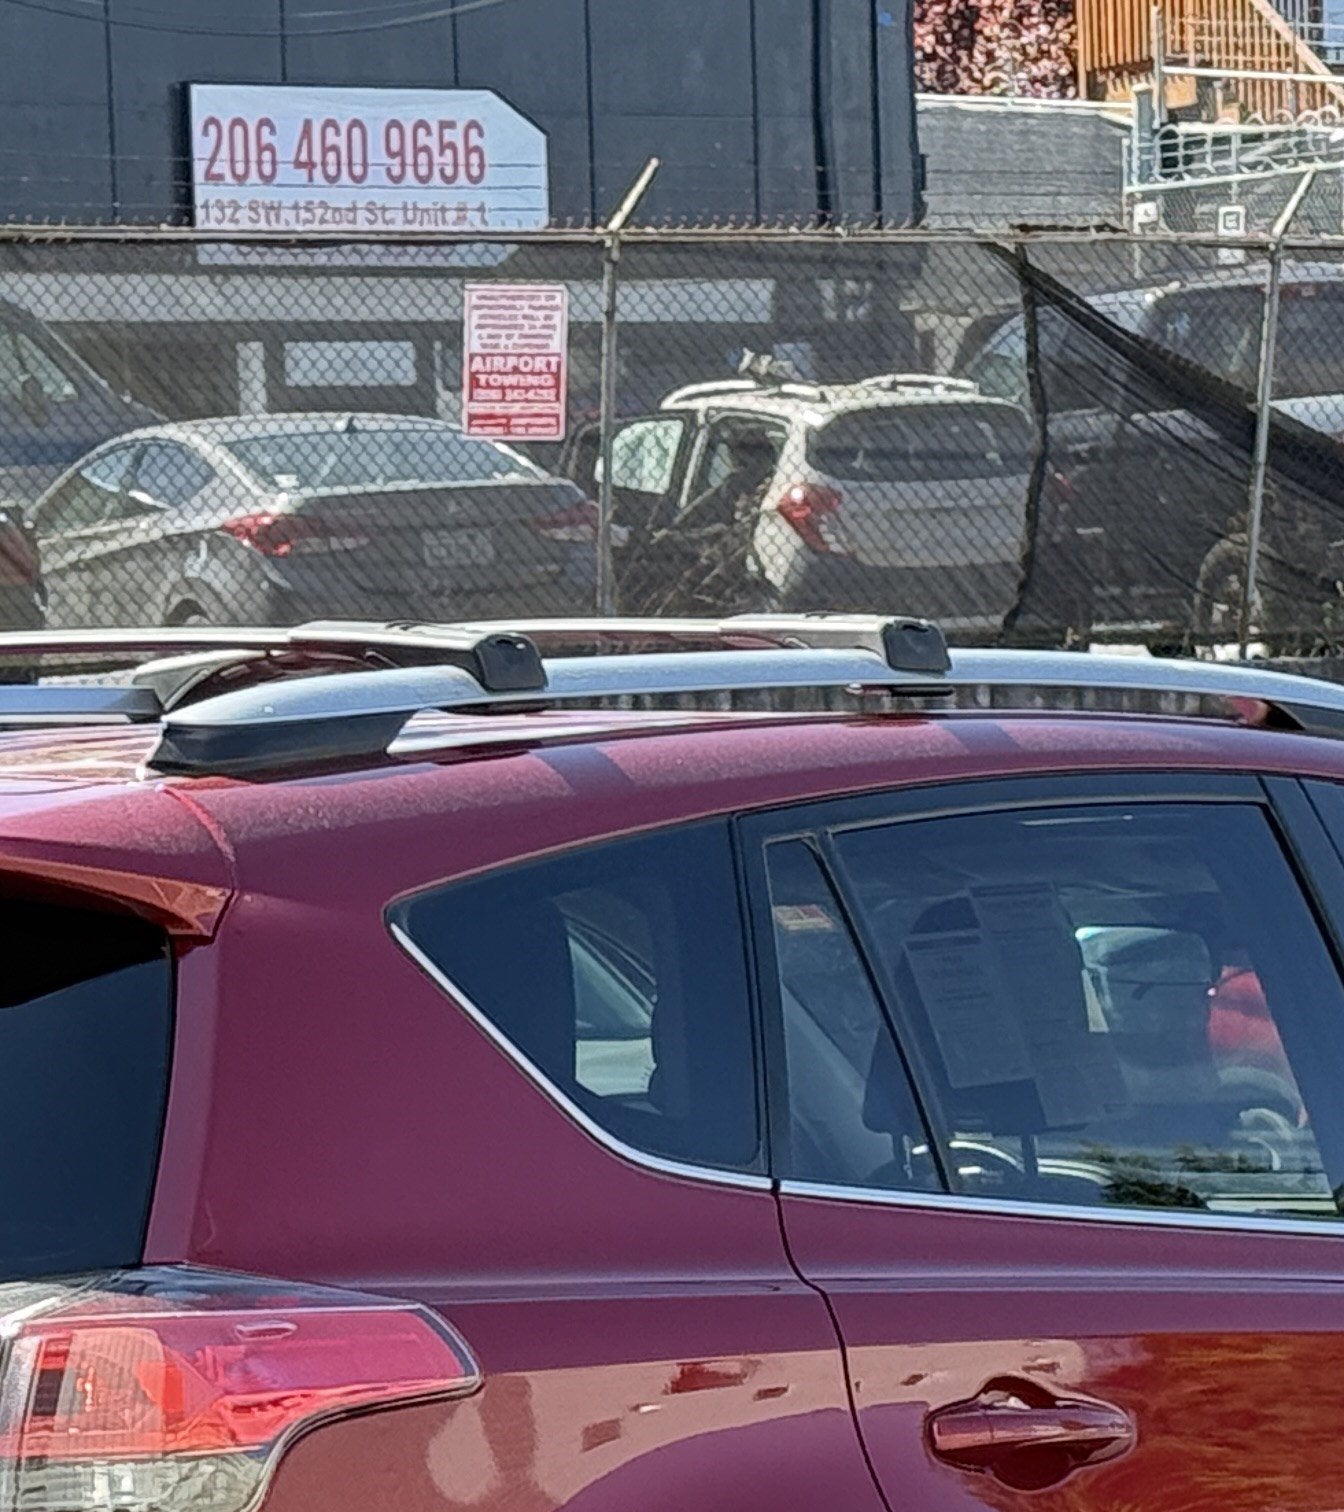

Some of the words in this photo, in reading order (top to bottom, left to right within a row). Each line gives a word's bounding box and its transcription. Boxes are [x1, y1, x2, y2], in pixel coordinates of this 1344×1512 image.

[202, 116, 277, 185] 206
[293, 118, 369, 185] 460
[384, 118, 486, 186] 9656
[400, 200, 451, 227] Unit
[470, 355, 561, 373] AIRPORT
[476, 373, 556, 388] TOWING
